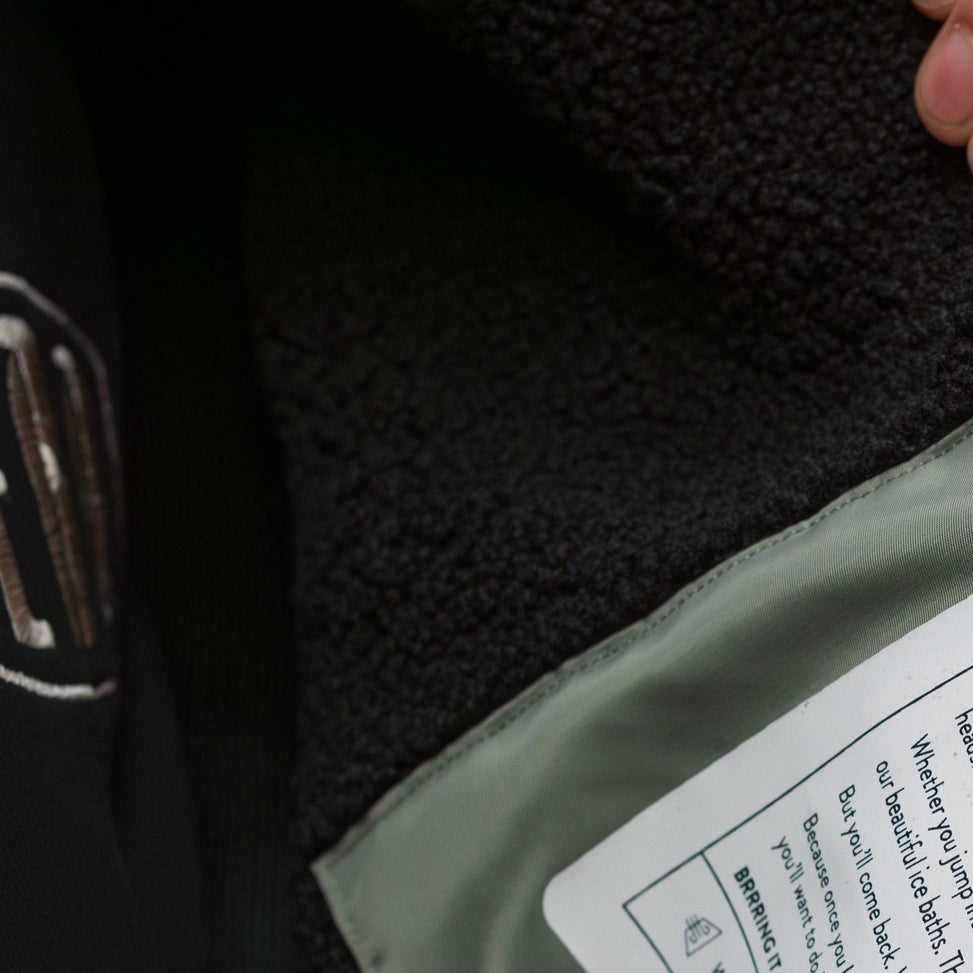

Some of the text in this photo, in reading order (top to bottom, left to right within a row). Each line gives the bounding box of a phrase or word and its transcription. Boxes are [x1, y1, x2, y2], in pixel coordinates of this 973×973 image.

[876, 760, 894, 789] our
[910, 733, 945, 814] Whether
[803, 812, 829, 888] Because
[885, 787, 928, 870] beautiful
[927, 816, 957, 853] you
[838, 784, 856, 822] But
[859, 872, 881, 921] come
[872, 918, 901, 970] back.
[908, 865, 930, 899] ice
[938, 850, 973, 900] jump
[733, 866, 776, 954] BRRRING
[766, 951, 784, 972] IT
[793, 884, 815, 929] want
[824, 890, 839, 933] once
[918, 895, 950, 955] baths.
[804, 927, 816, 949] to
[827, 933, 847, 967] you
[808, 951, 823, 973] do
